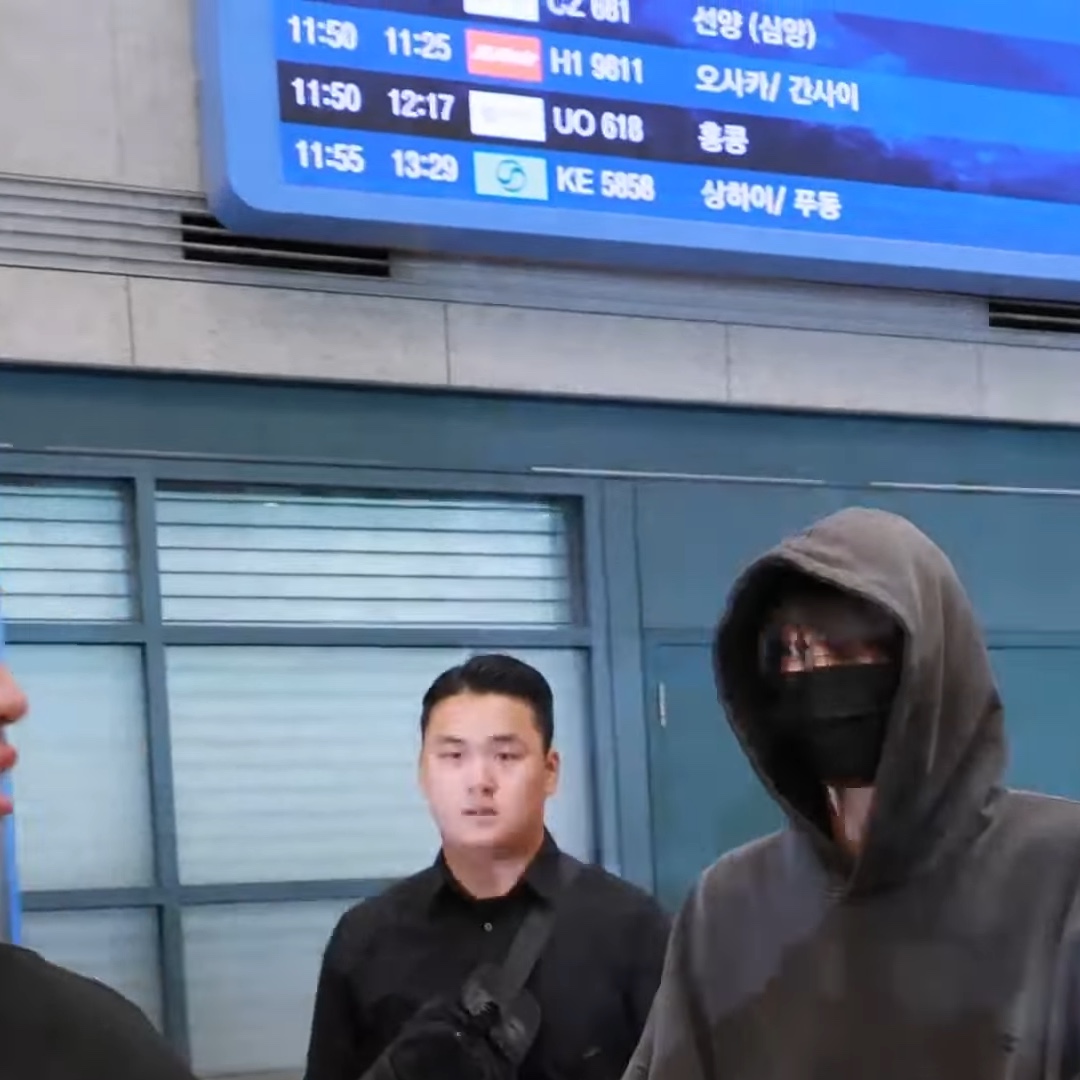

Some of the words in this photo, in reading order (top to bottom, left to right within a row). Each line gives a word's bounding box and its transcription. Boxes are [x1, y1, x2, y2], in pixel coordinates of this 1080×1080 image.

[288, 15, 358, 50] 11:50
[385, 26, 452, 61] 11:25
[696, 64, 781, 102] 오사카/
[789, 75, 859, 111] 간사이
[291, 77, 362, 112] 11:50
[387, 88, 455, 121] 12:17
[552, 106, 596, 137] UO
[295, 140, 365, 173] 11:55
[391, 149, 459, 182] 13:29
[556, 166, 594, 195] KE
[701, 180, 787, 216] 상하이/
